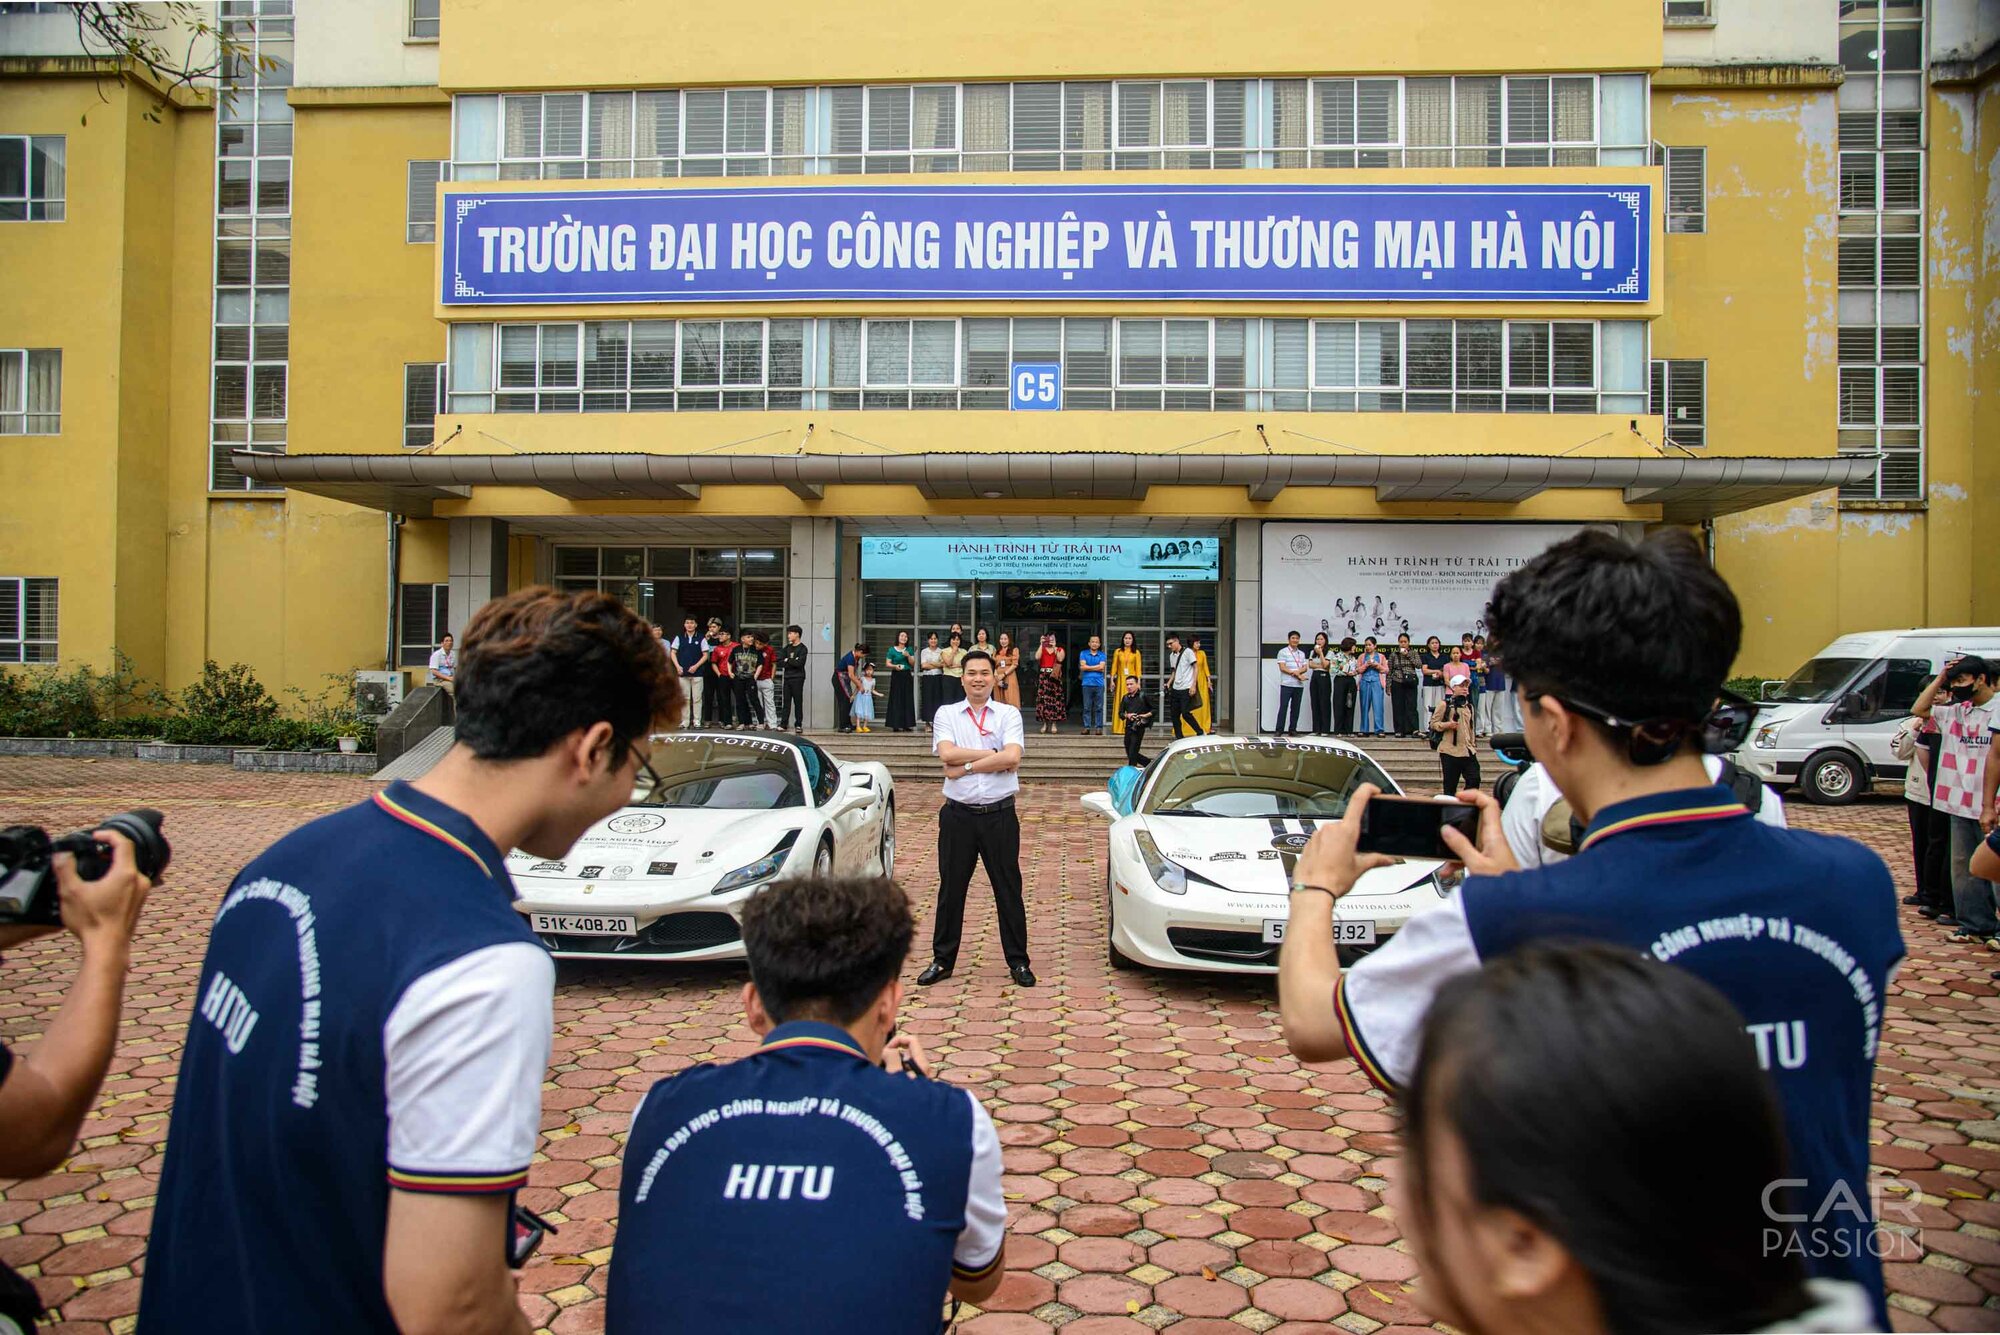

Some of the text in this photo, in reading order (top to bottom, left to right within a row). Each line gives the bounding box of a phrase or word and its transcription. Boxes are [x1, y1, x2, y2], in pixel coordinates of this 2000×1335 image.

[478, 210, 1615, 281] TRƯỜNG ĐẠI HỌC CÔNG NGHIỆP VÀ THƯƠNG MẠI HÀ NỘI
[1017, 372, 1055, 402] C5
[948, 541, 1122, 554] HÀNH TRÌNH TỪ TRÁI TIM
[1348, 555, 1388, 566] HÀNH
[1395, 555, 1439, 566] TRÌNH
[1445, 555, 1465, 567] TỪ
[1468, 555, 1500, 567] TRÁI
[664, 735, 701, 743] No.1
[713, 736, 789, 755] COFFEE!
[1186, 745, 1223, 756] THE
[1285, 743, 1363, 761] COFFEE!
[1166, 851, 1202, 861] Legend
[539, 916, 628, 932] 51K-408.20
[1651, 925, 1701, 962] CÔNG
[1698, 912, 1765, 943] NGHIỆP
[1767, 917, 1792, 942] VÀ
[202, 970, 260, 1055] HITU
[299, 1000, 322, 1040] MẠI
[299, 1042, 323, 1070] HÀ
[664, 1127, 691, 1152] ĐẠI
[689, 1108, 720, 1132] HỌC
[720, 1098, 763, 1120] CÔNG
[765, 1096, 818, 1116] NGHIỆP
[818, 1098, 841, 1116] VÀ
[839, 1104, 894, 1147] THƯƠNG
[885, 1140, 913, 1170] MẠI
[899, 1169, 923, 1191] HÀ
[723, 1163, 835, 1201] HITU
